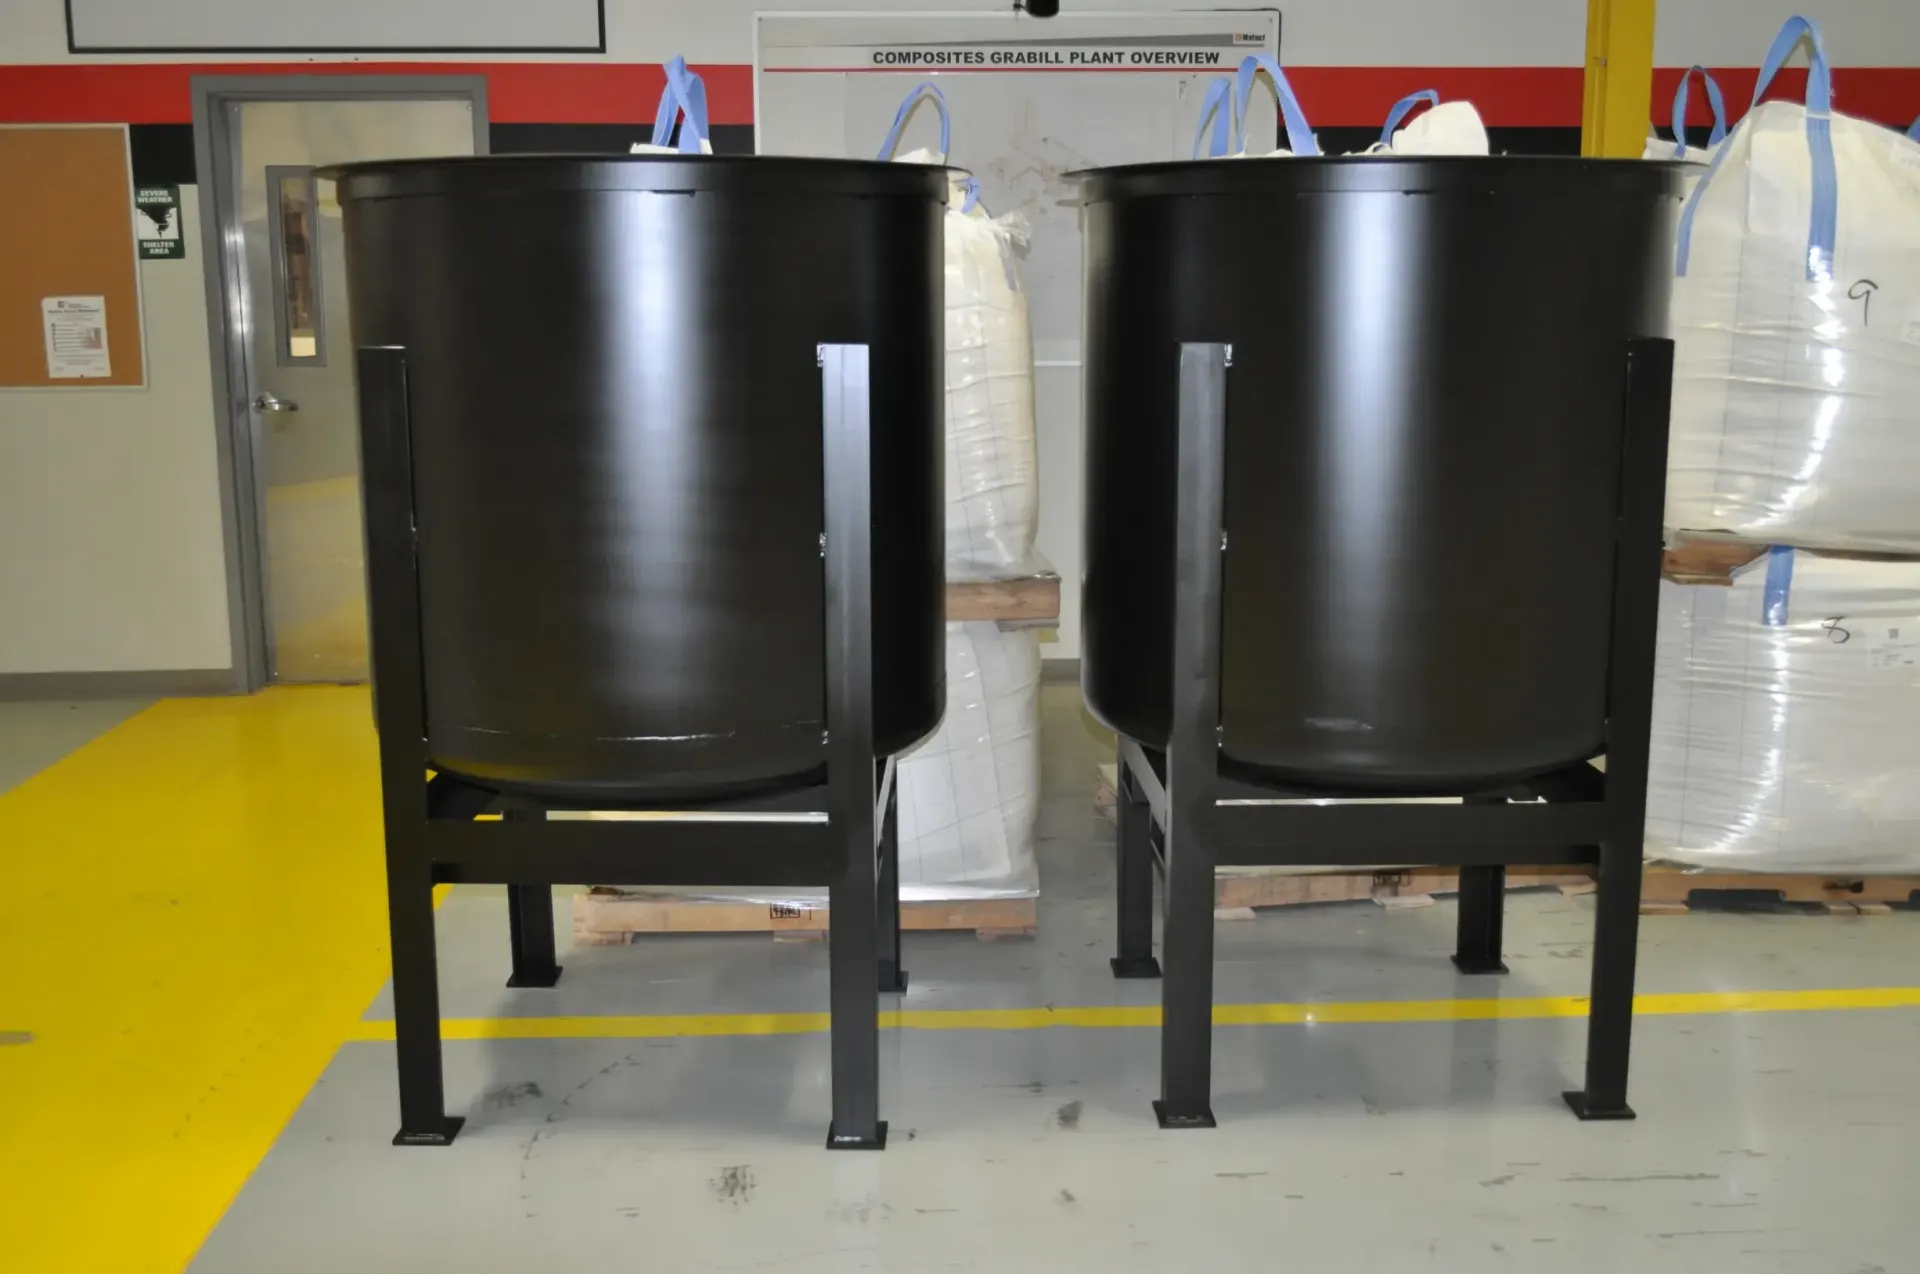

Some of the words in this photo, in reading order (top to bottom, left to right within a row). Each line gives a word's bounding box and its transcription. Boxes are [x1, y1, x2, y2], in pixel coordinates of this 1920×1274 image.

[873, 51, 985, 64] COMPOSITES
[990, 51, 1064, 64] GRABILL
[1070, 51, 1125, 64] PLANT
[1130, 51, 1220, 64] OVERVIEW
[137, 196, 173, 204] WEATHER
[143, 241, 175, 249] SHELTER
[1847, 278, 1879, 327] 9
